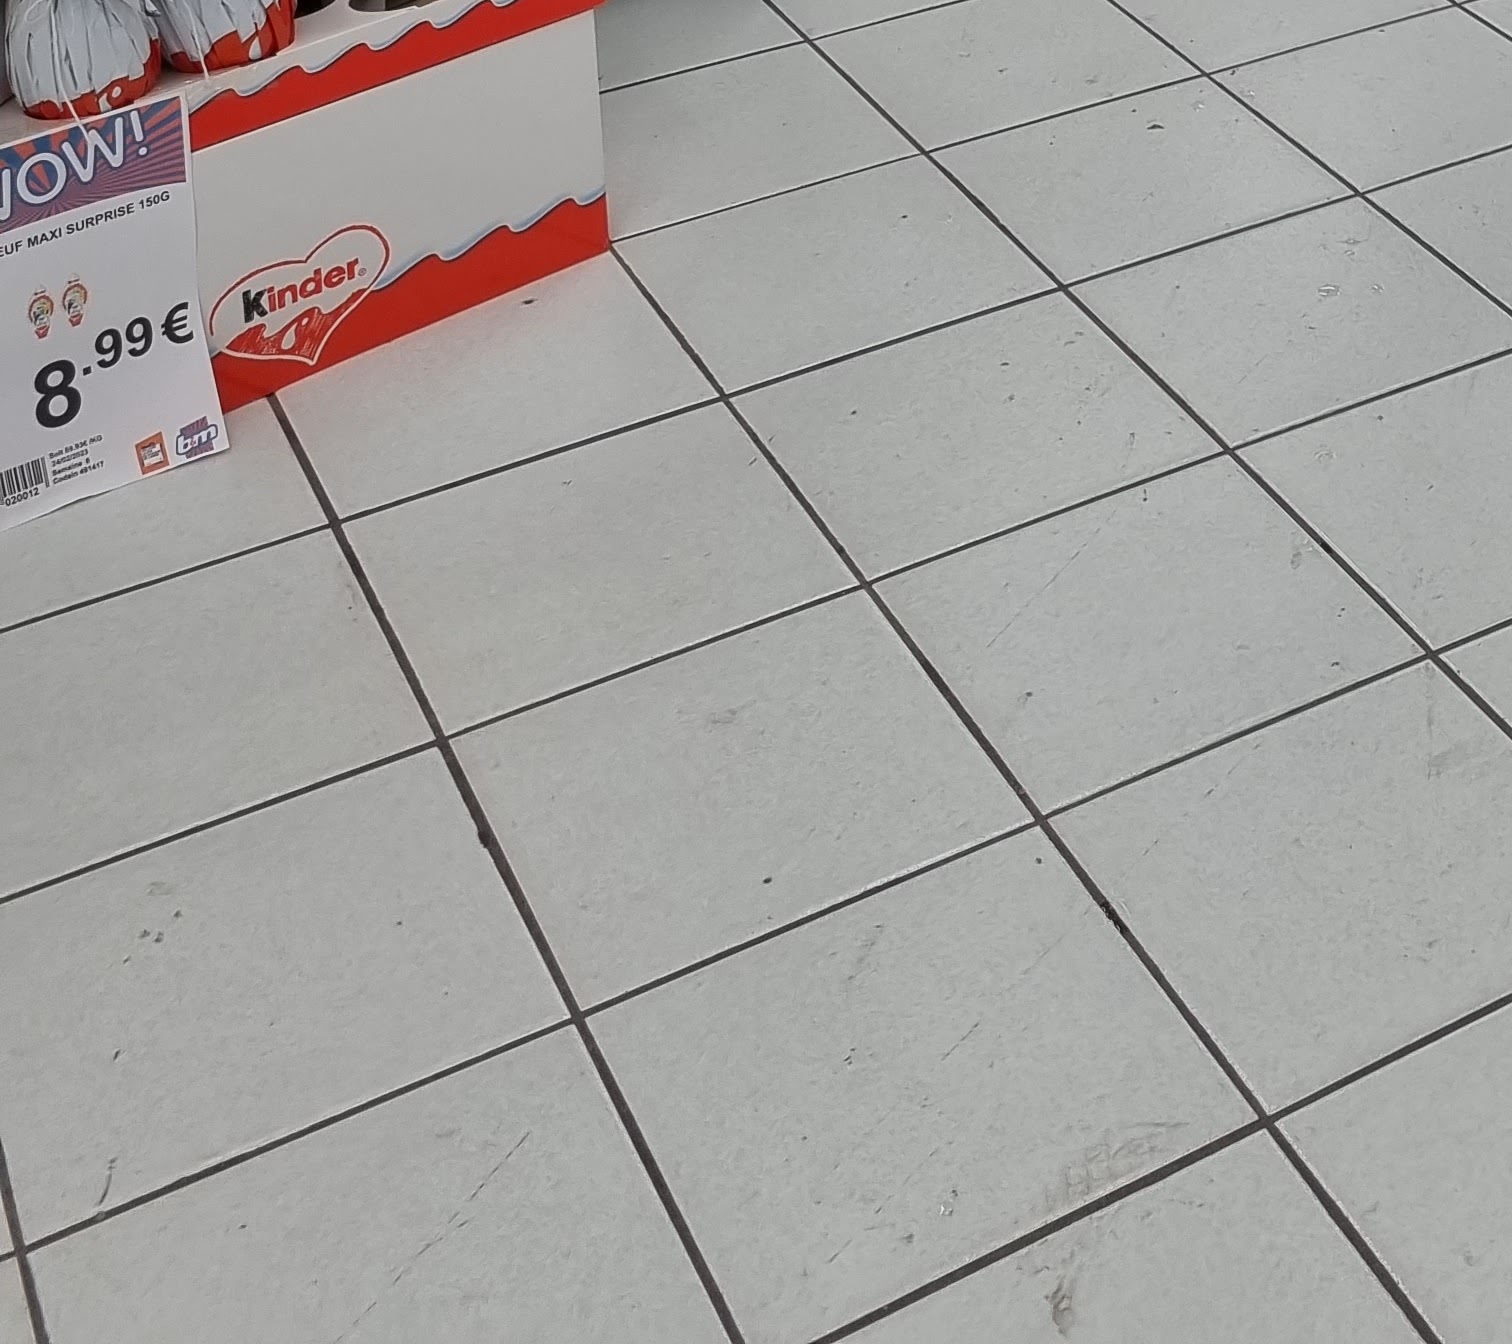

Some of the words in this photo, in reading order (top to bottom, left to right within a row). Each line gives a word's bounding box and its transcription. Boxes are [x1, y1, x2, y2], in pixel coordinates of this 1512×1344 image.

[0, 109, 146, 221] OW!
[27, 227, 62, 249] MAXI
[66, 202, 136, 235] SURPRISE
[138, 191, 171, 210] 150G
[242, 257, 360, 324] Kinder
[5, 487, 40, 507] 020012
[52, 461, 83, 476] Semaine
